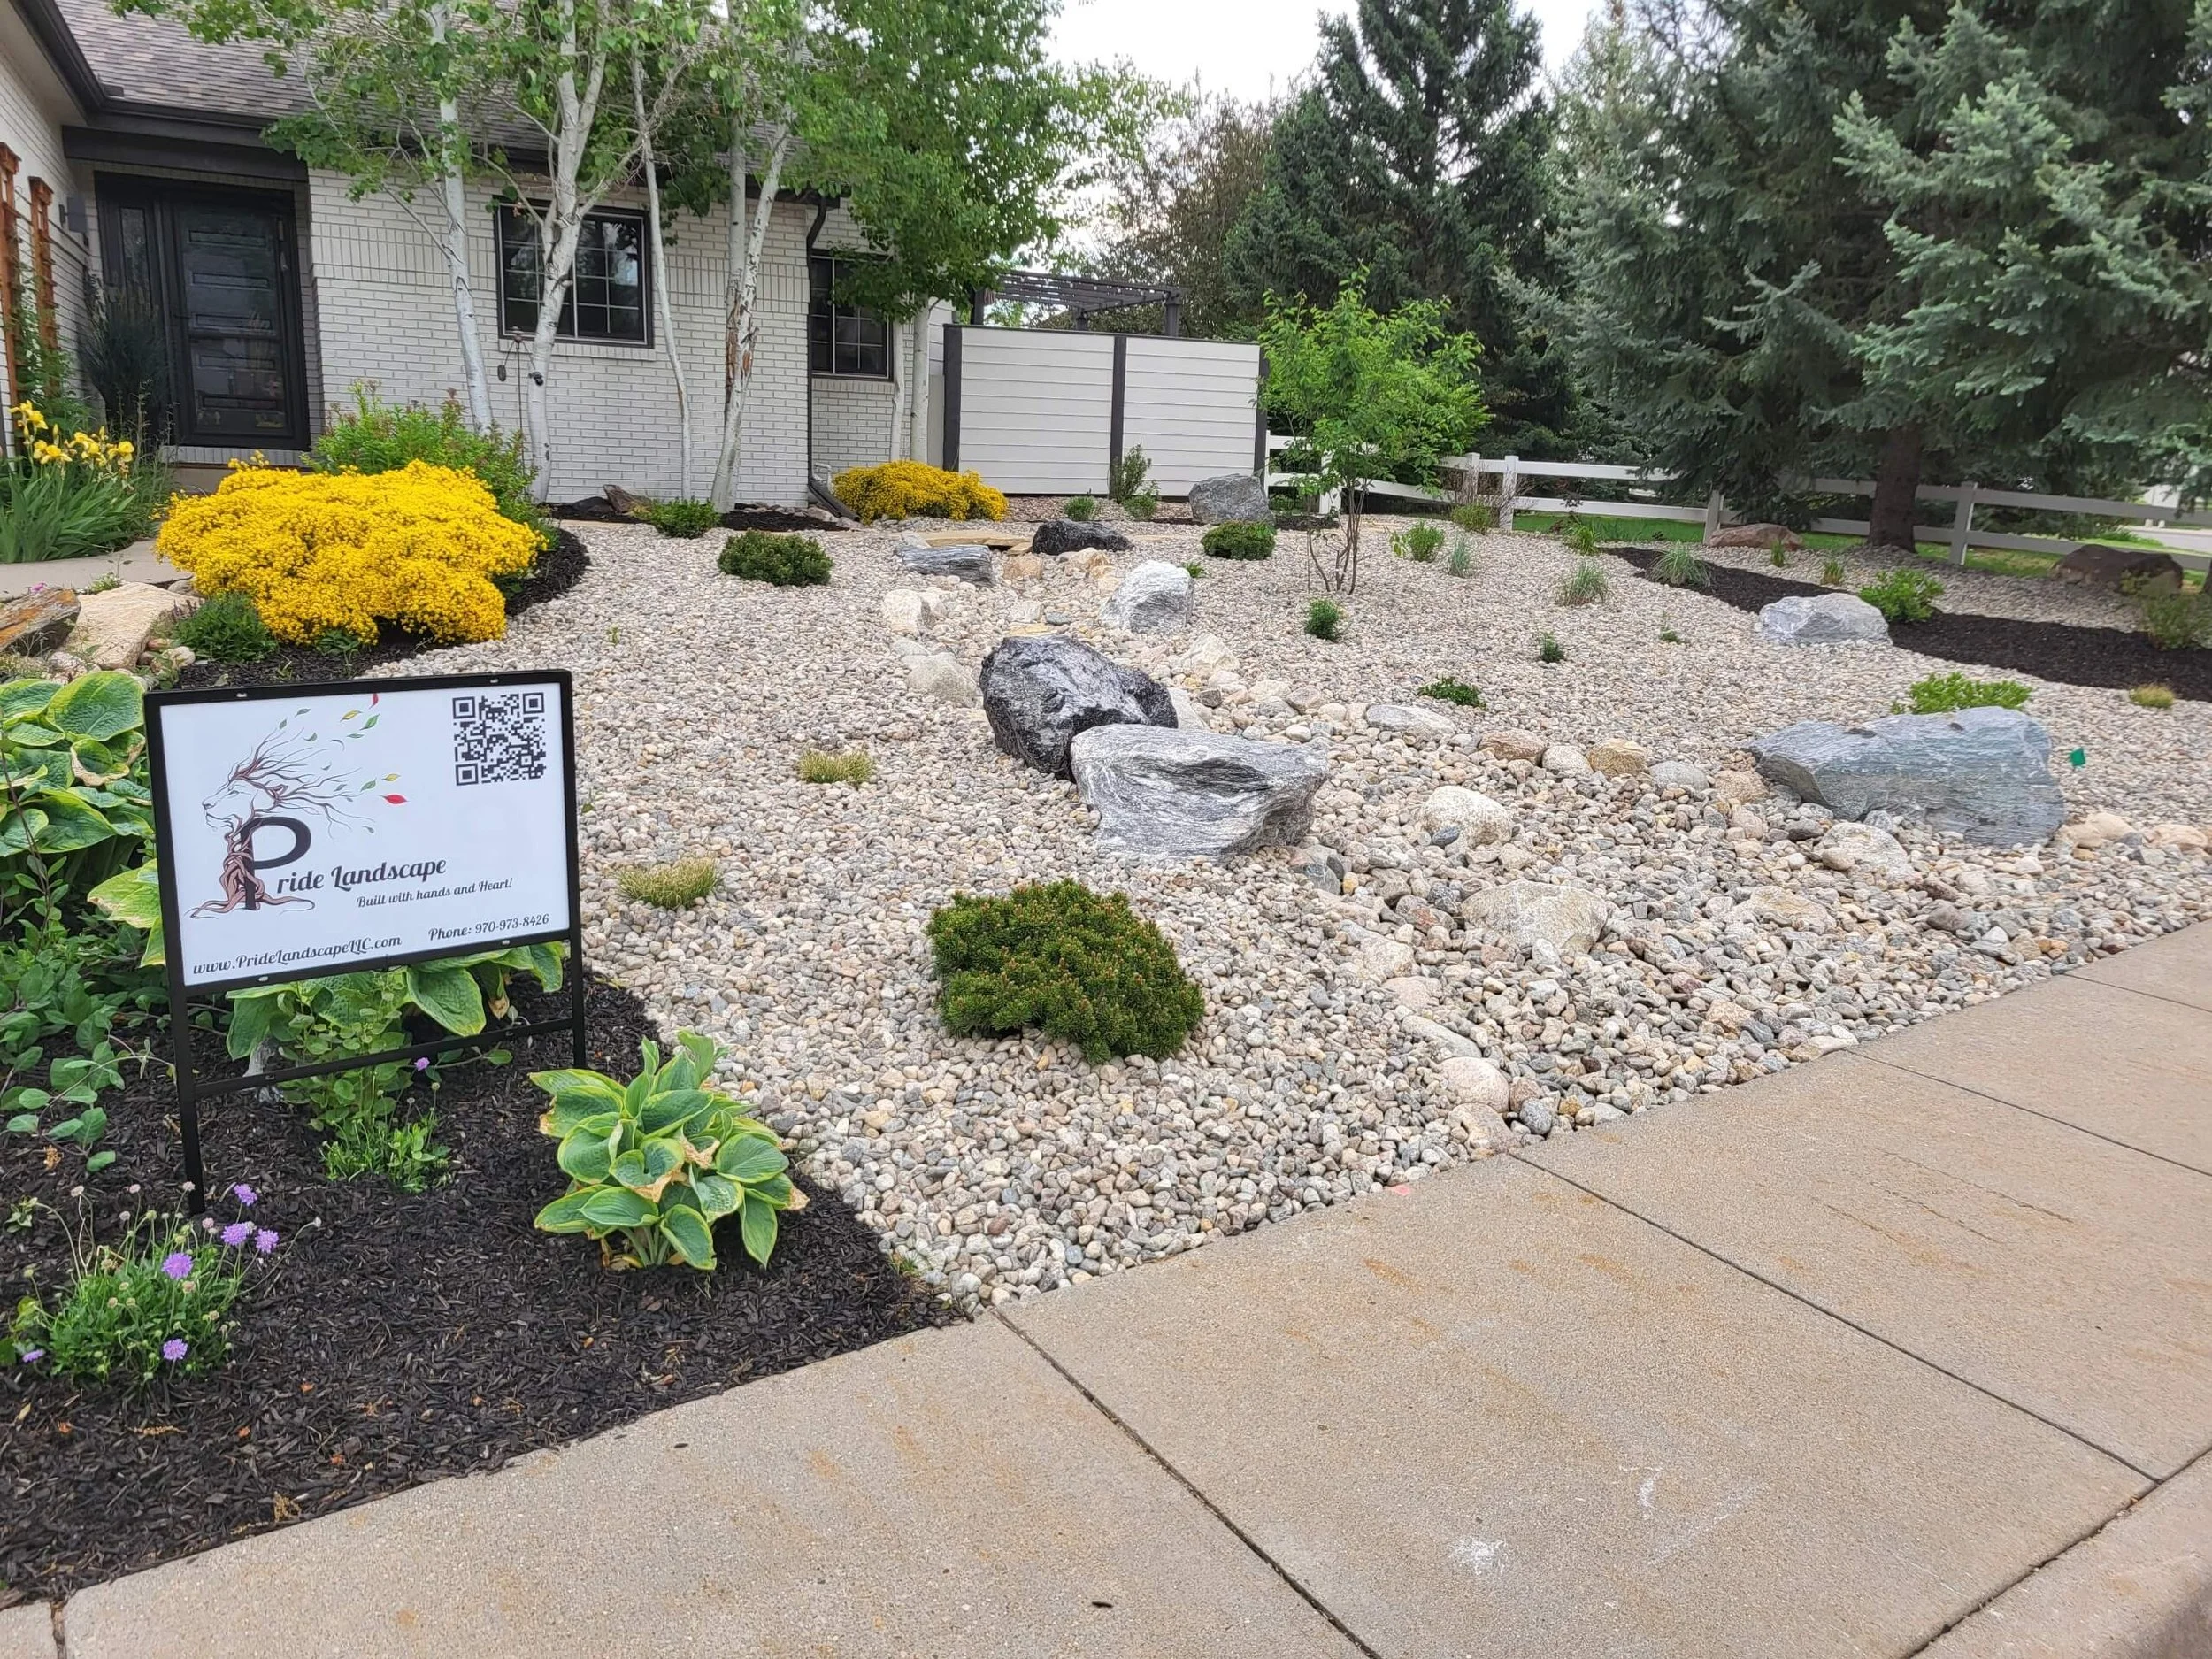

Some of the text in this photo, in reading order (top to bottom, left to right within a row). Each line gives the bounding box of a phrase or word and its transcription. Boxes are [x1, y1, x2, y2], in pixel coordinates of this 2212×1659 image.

[239, 816, 447, 910] Pride Landscape
[357, 878, 512, 908] Built with hands and Heart!
[428, 914, 549, 941] Phone: 970-973-8426
[193, 934, 402, 974] www.PrideLandscapeLLC.com
